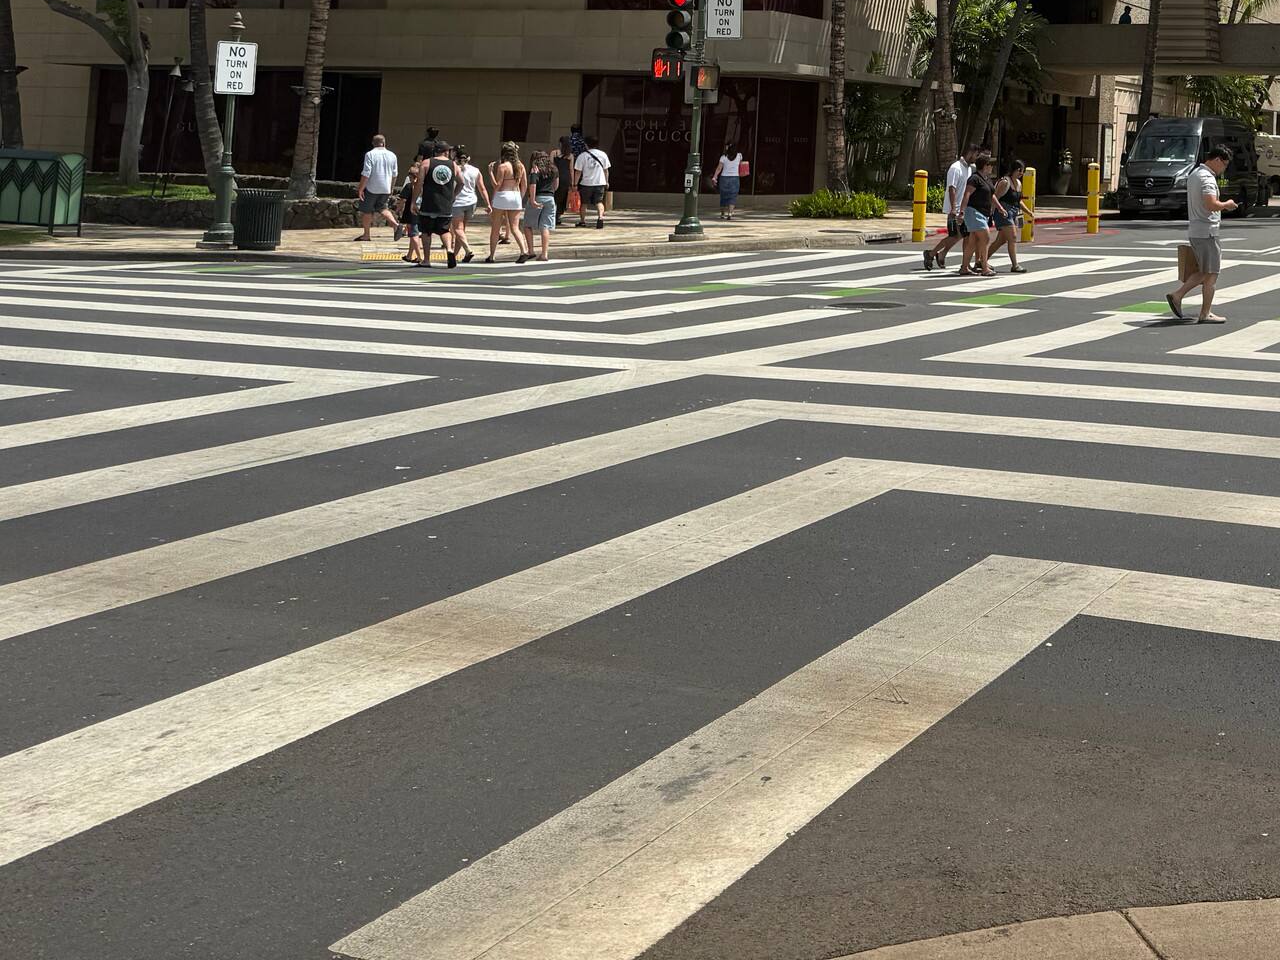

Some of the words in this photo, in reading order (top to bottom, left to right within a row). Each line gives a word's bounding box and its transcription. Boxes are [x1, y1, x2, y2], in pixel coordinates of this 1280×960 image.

[716, 28, 732, 36] RED
[229, 46, 246, 57] NO
[226, 60, 248, 68] TURN
[230, 71, 242, 79] ON
[226, 82, 243, 90] RED
[645, 130, 692, 142] GUCC
